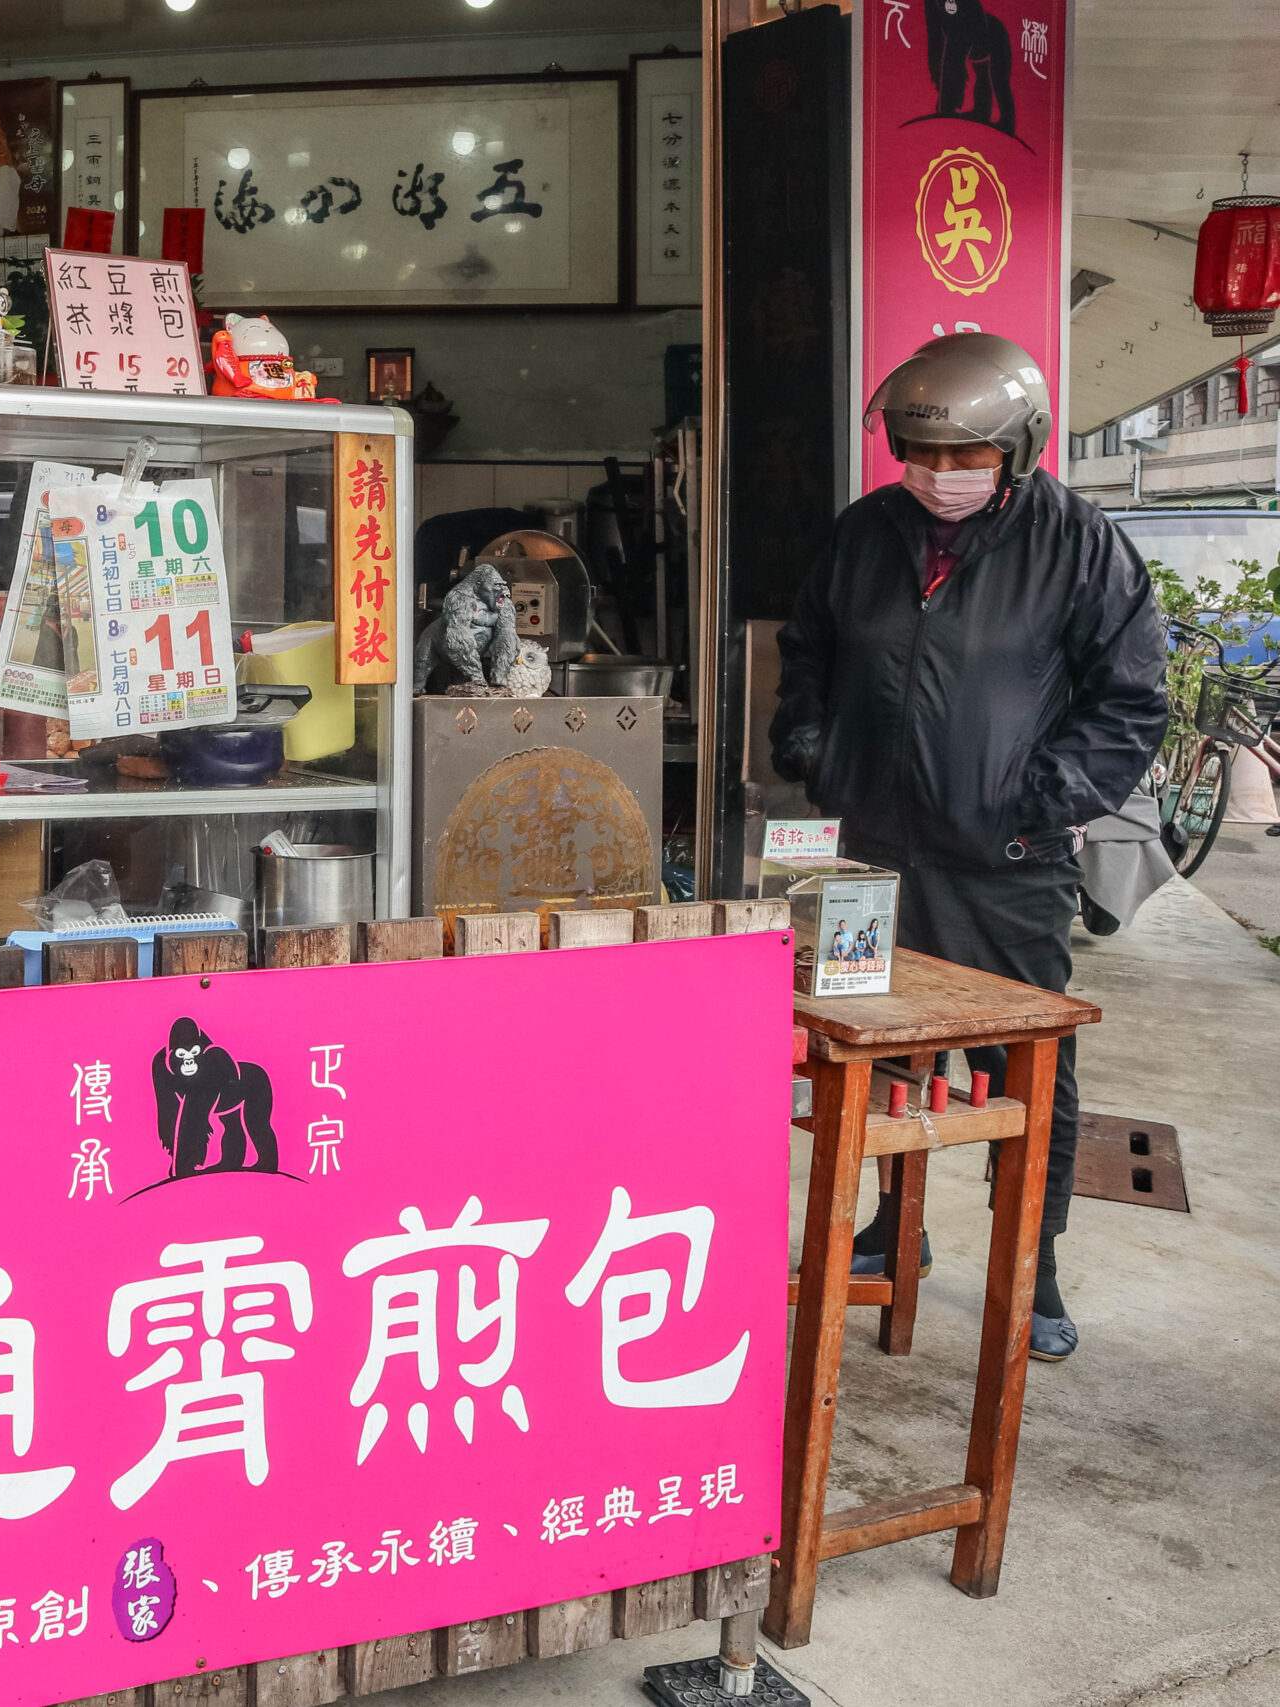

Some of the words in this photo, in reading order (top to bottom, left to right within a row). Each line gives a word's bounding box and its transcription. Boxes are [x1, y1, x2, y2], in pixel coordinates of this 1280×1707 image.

[25, 205, 47, 215] 2024
[935, 165, 993, 277] 吳
[58, 262, 93, 336] 紅茶
[76, 351, 100, 374] 15
[107, 264, 134, 336] 豆漿
[150, 268, 184, 339] 煎包
[120, 353, 141, 376] 15
[166, 356, 190, 378] 20
[904, 402, 949, 421] SUPA
[134, 499, 209, 558] 10
[347, 459, 392, 667] 請先付款
[99, 535, 122, 613] 七月初七日
[136, 556, 212, 578] 星期六
[145, 610, 214, 671] 11
[110, 650, 131, 728] 七月初八日
[147, 667, 221, 693] 星期日
[68, 1060, 113, 1200] 傳承
[308, 1044, 346, 1175] 正宗
[123, 1546, 161, 1636] 張家
